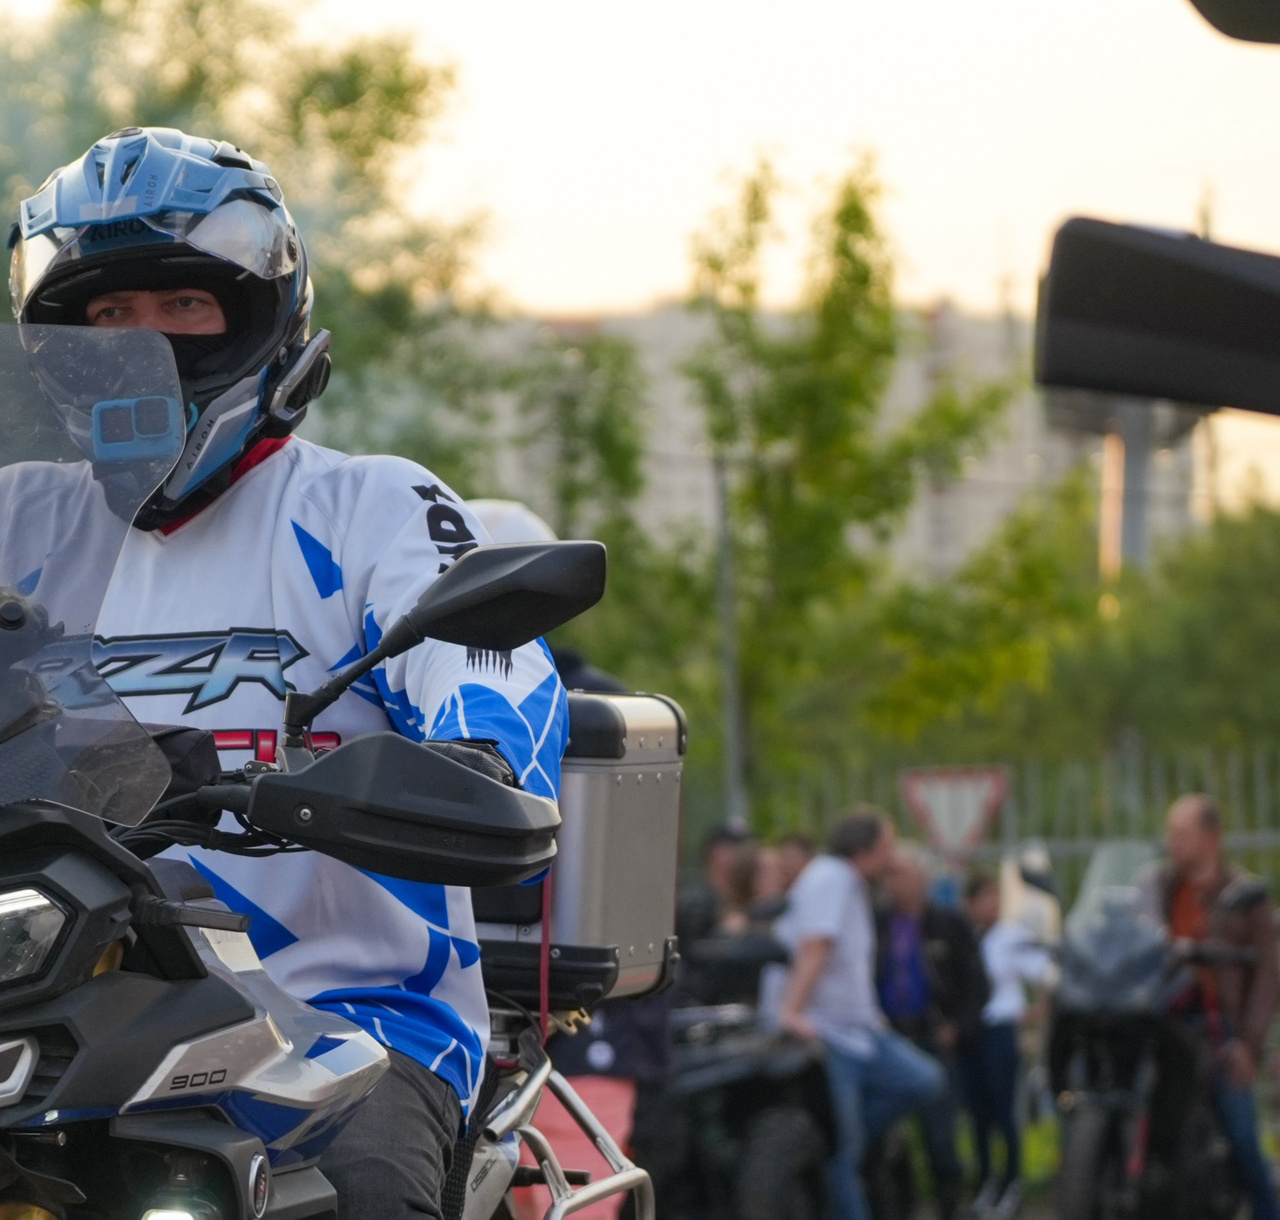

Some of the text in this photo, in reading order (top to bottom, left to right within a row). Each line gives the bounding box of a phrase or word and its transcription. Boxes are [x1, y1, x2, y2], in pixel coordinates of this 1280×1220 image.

[144, 174, 158, 207] AIROH
[90, 220, 153, 242] AIRO
[186, 419, 214, 470] AIROH
[170, 1069, 227, 1090] 900
